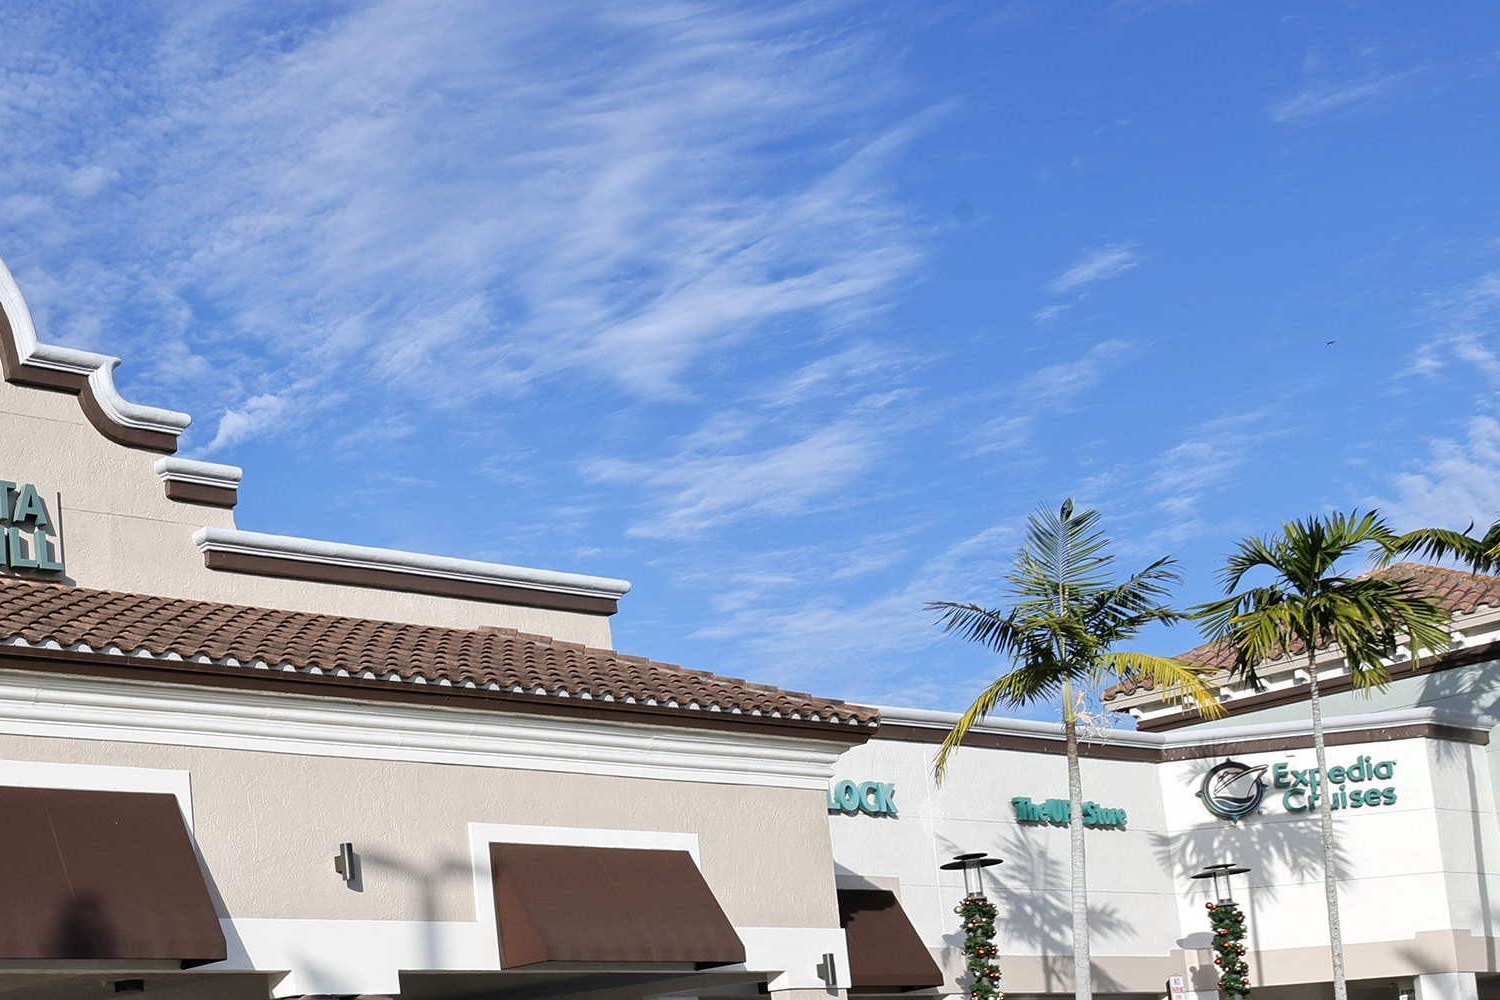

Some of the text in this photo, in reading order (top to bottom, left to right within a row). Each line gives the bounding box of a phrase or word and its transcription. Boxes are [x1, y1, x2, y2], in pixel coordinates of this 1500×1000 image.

[1272, 755, 1395, 792] Expedia
[1011, 796, 1128, 825] The UP Store
